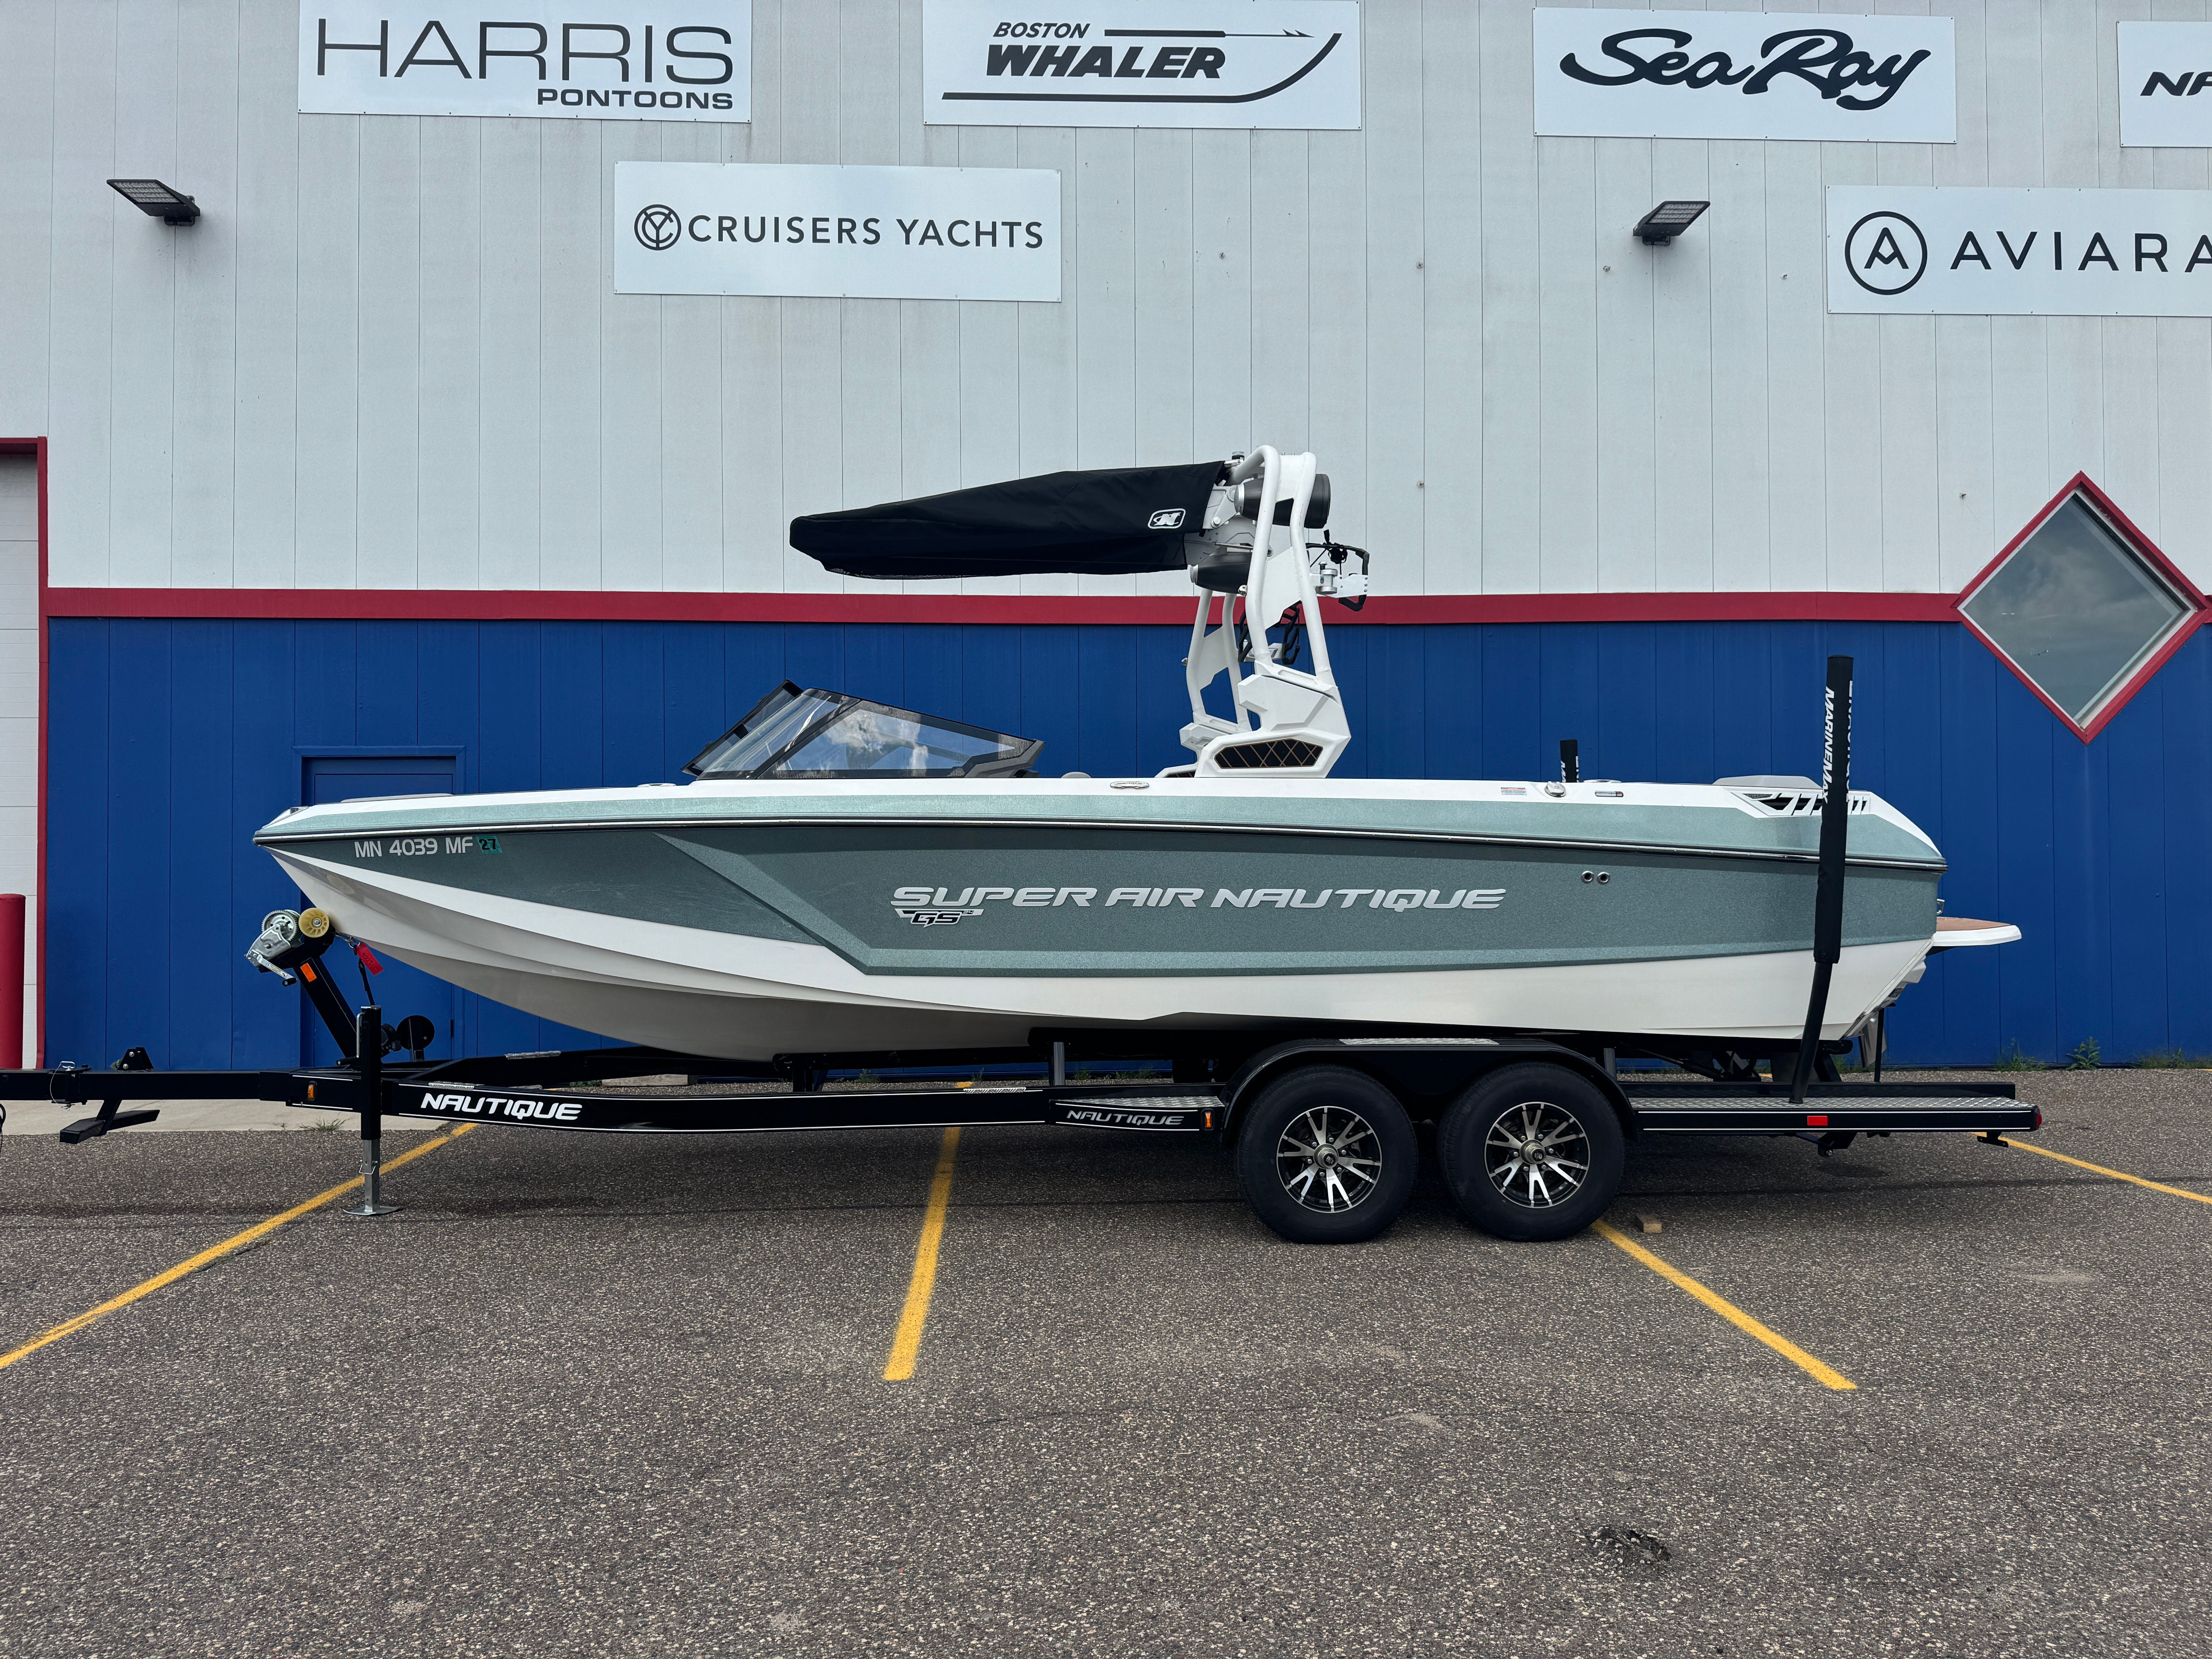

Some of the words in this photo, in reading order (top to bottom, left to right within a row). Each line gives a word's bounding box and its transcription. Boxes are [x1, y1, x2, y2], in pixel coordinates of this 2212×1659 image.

[993, 22, 1091, 38] BOSTON
[318, 19, 733, 84] HARRIS
[987, 45, 1225, 79] WHALER
[1560, 29, 1755, 89] Sea
[1742, 29, 1931, 110] Ray
[538, 89, 733, 109] PONTOONS
[689, 215, 880, 245] CRUISERS
[896, 219, 1042, 249] YACHTS
[354, 841, 382, 858] MN
[389, 838, 438, 856] 4039
[445, 836, 473, 854] MF
[479, 838, 497, 850] 27
[890, 887, 1097, 906] SUPER
[1104, 888, 1204, 907] AIR
[1210, 888, 1506, 912] NAUTIQUE
[911, 912, 962, 927] GS
[421, 1093, 582, 1120] NAUTIQUE
[1066, 1109, 1185, 1125] NAUTIQUE
